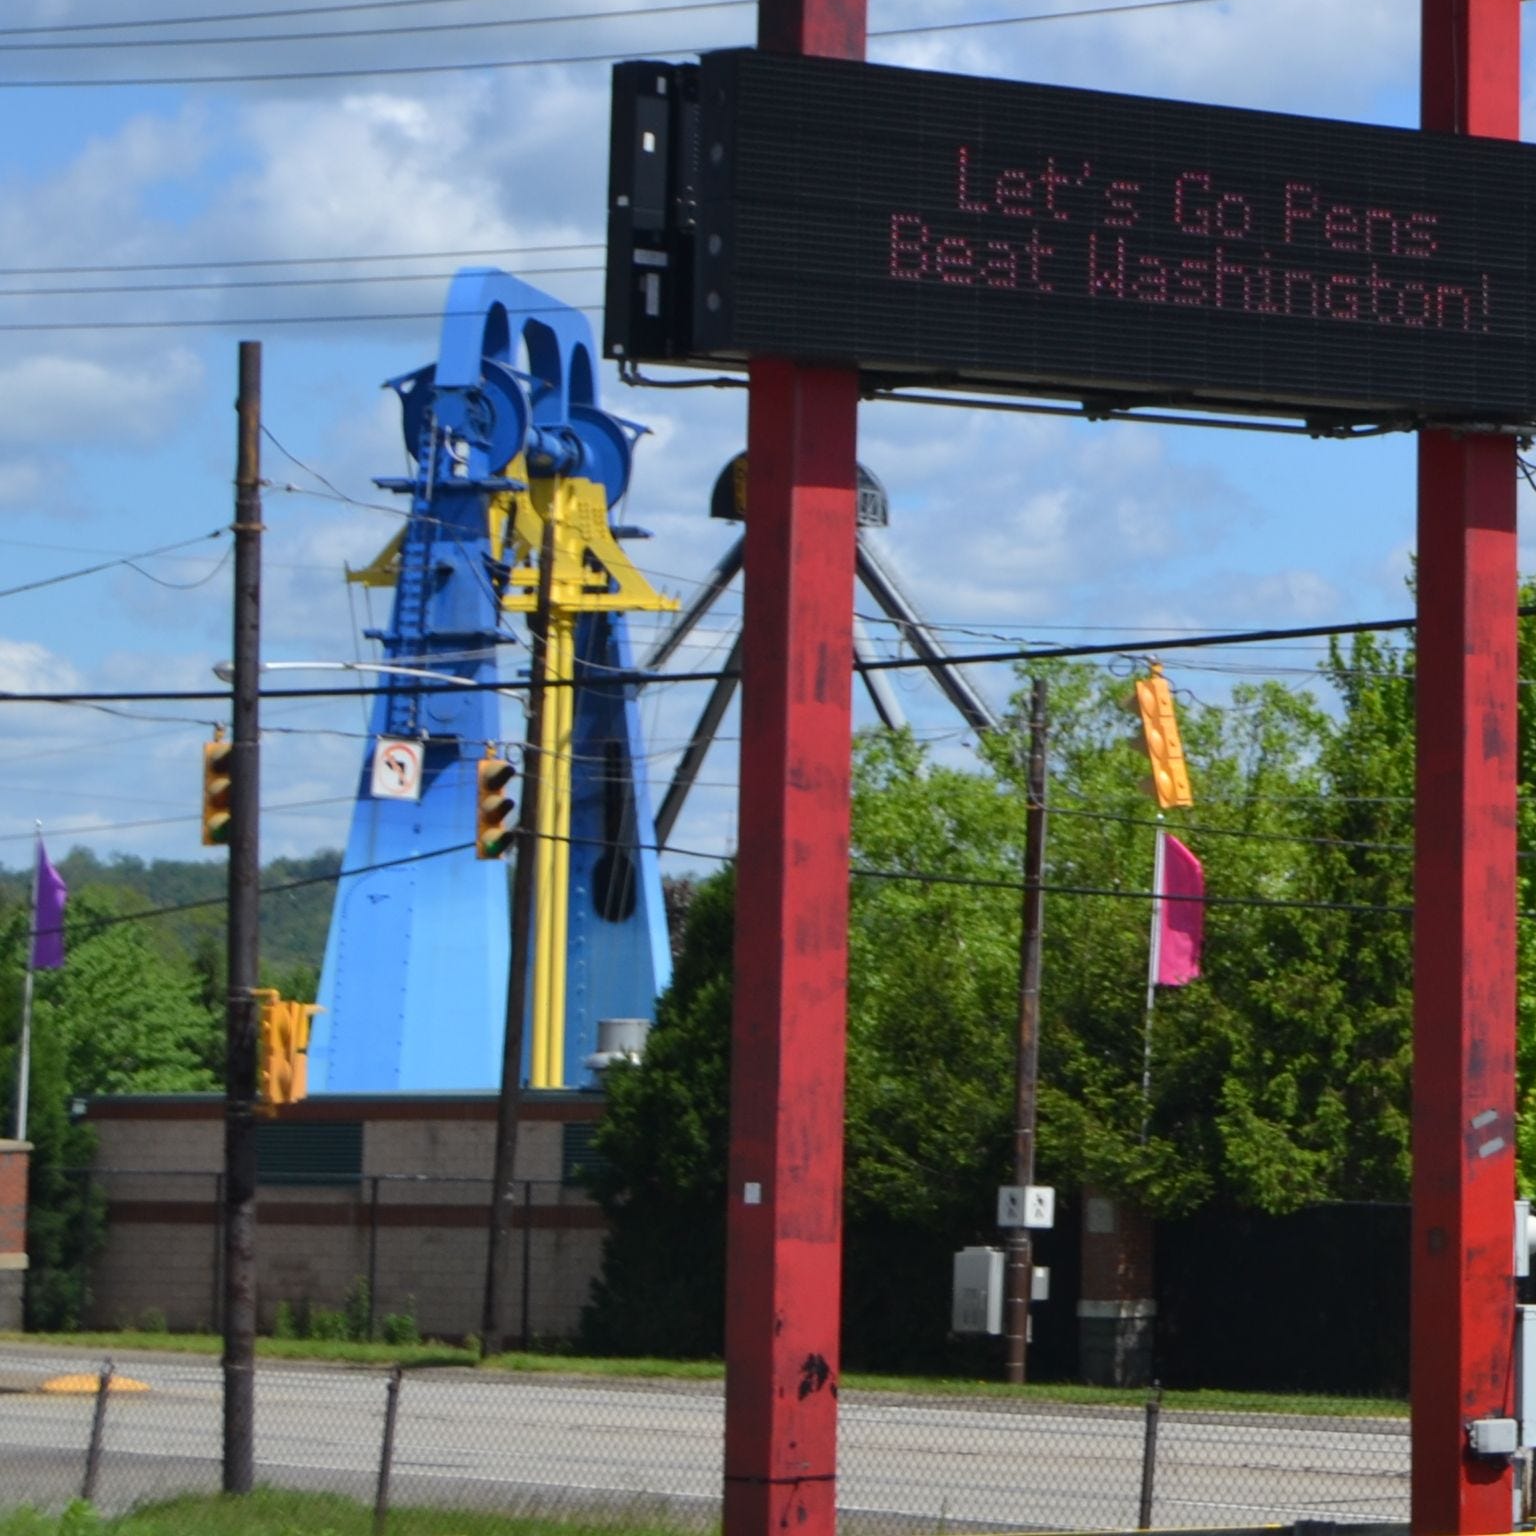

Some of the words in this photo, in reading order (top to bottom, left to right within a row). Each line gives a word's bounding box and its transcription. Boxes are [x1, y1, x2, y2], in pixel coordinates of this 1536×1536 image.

[957, 146, 1142, 228] Let's
[1174, 170, 1253, 239] Go
[1284, 181, 1441, 258] Pens
[890, 213, 1056, 293] Beat
[1088, 231, 1489, 333] Washington!
